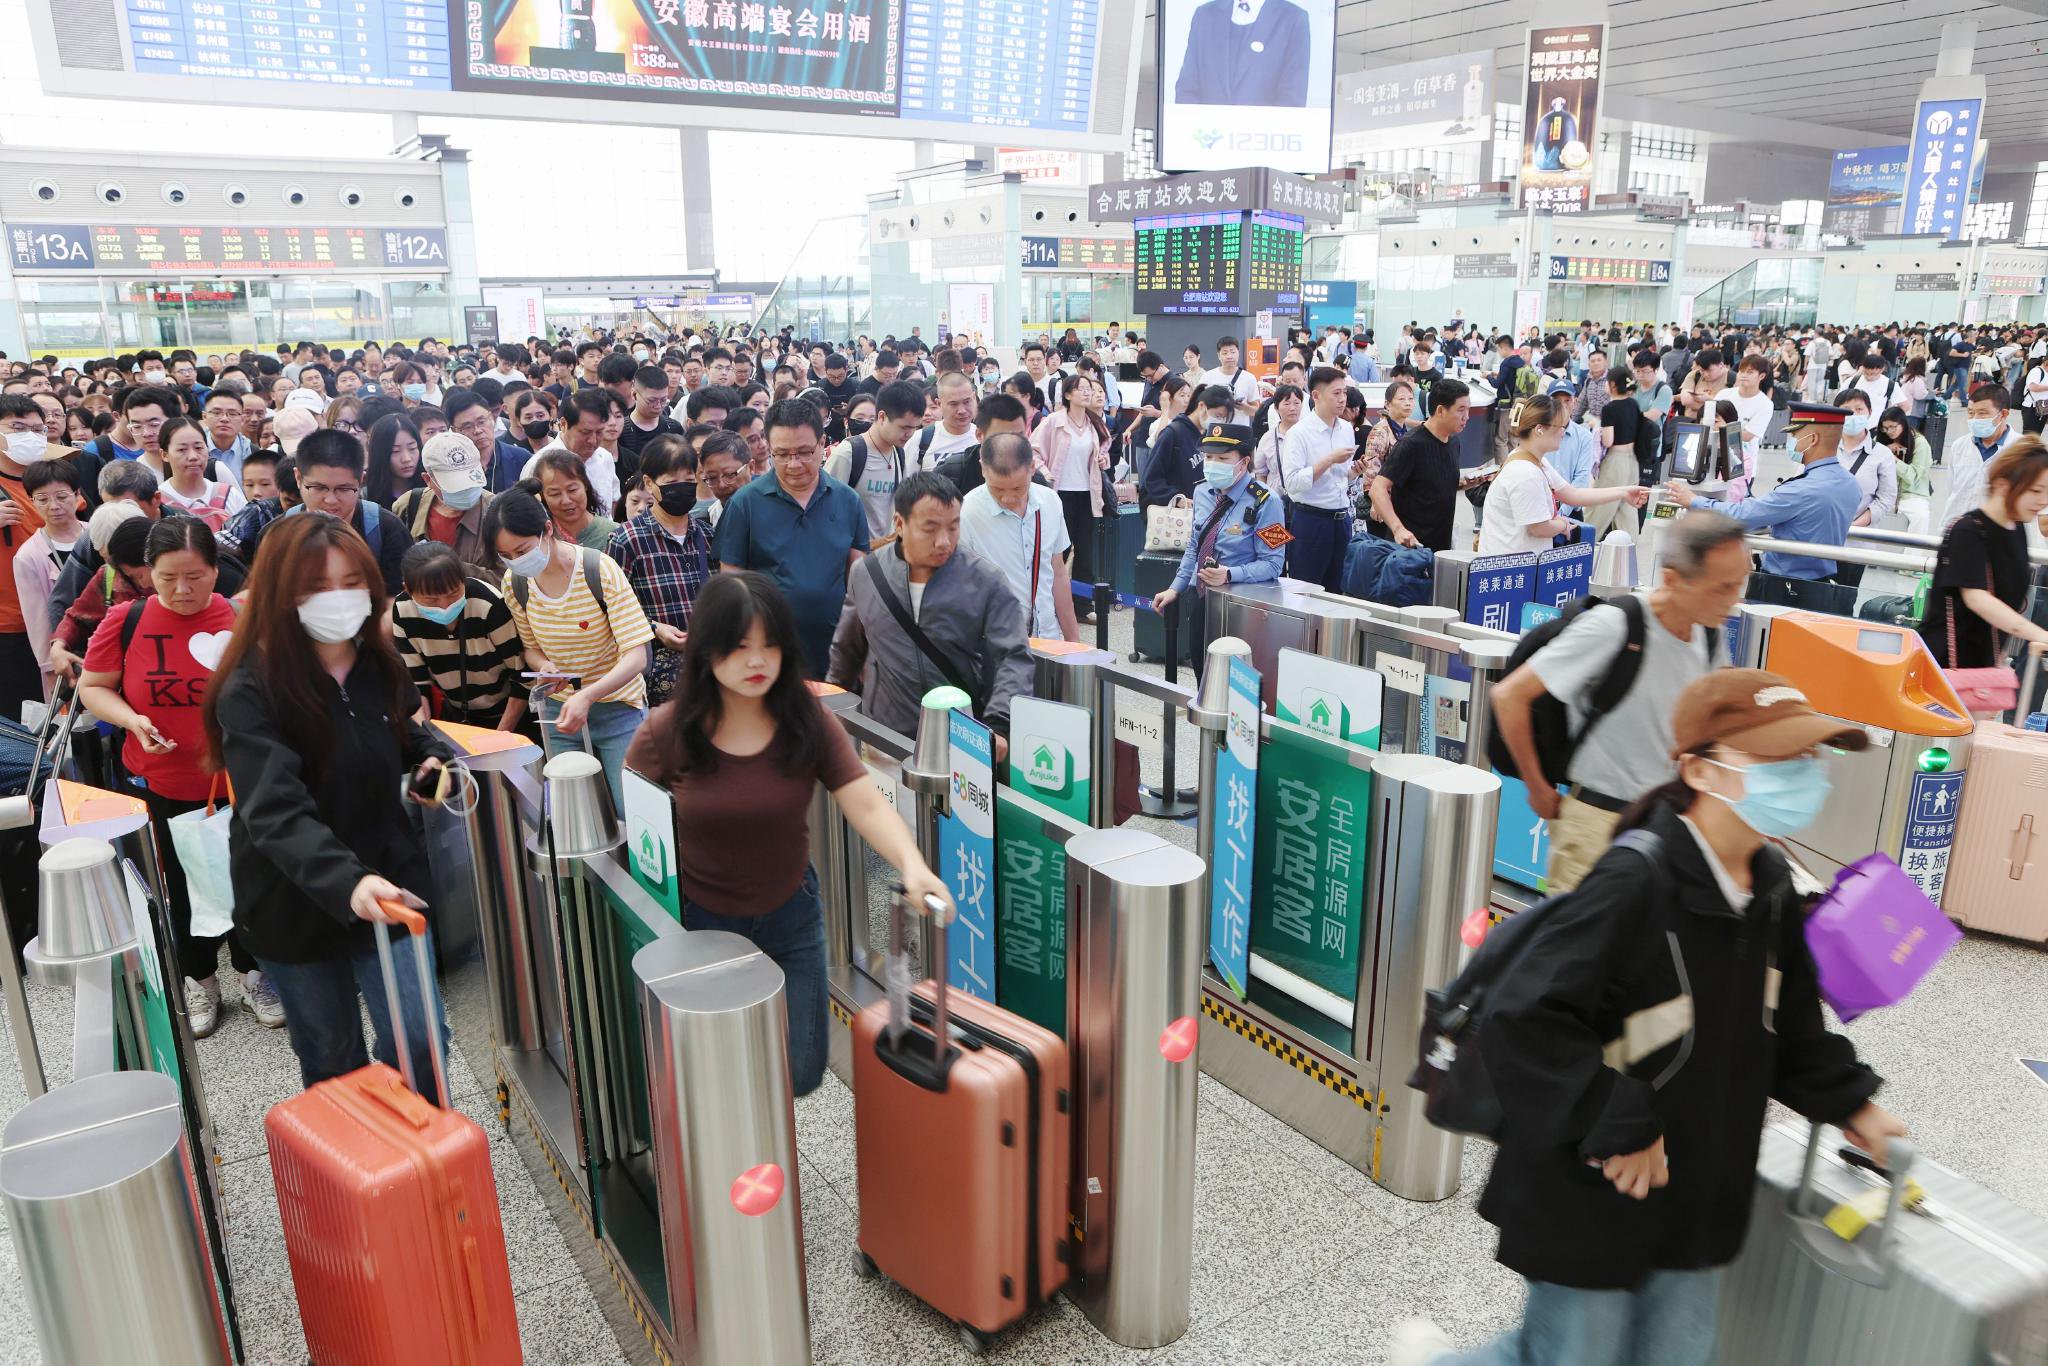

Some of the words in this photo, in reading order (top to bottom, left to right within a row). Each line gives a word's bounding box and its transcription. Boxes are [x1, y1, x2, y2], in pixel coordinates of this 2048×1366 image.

[653, 0, 871, 44] 安徽高端宴会用酒
[632, 53, 667, 69] 1388
[1531, 48, 1600, 66] 洞藏至高点
[1530, 65, 1599, 83] 世界大金奖
[1228, 133, 1303, 153] 12306
[1842, 165, 1874, 177] 中秋夜
[1096, 176, 1239, 214] 合肥南站欢迎您
[1271, 176, 1340, 216] 合肥南站欢迎您
[14, 229, 31, 264] 检票口
[35, 233, 88, 261] 13A
[402, 235, 444, 260] 12A
[1032, 243, 1057, 262] 11A
[1552, 260, 1566, 277] 9A
[1657, 264, 1669, 280] 8A
[1478, 574, 1525, 594] 换乘通道
[1546, 563, 1583, 584] 换乘通道
[1483, 601, 1510, 632] 刷
[142, 634, 177, 676] I
[1119, 716, 1158, 740] HFN-11-2
[1029, 767, 1059, 784] Anjuke
[953, 771, 989, 816] 58同城
[1911, 838, 1952, 848] Transfer
[1912, 824, 1954, 838] 便捷换乘
[1221, 773, 1250, 960] 找工作
[1271, 776, 1321, 945] 安居客
[1320, 795, 1354, 960] 全房源网
[956, 840, 988, 997] 找工
[1002, 837, 1044, 976] 安居客
